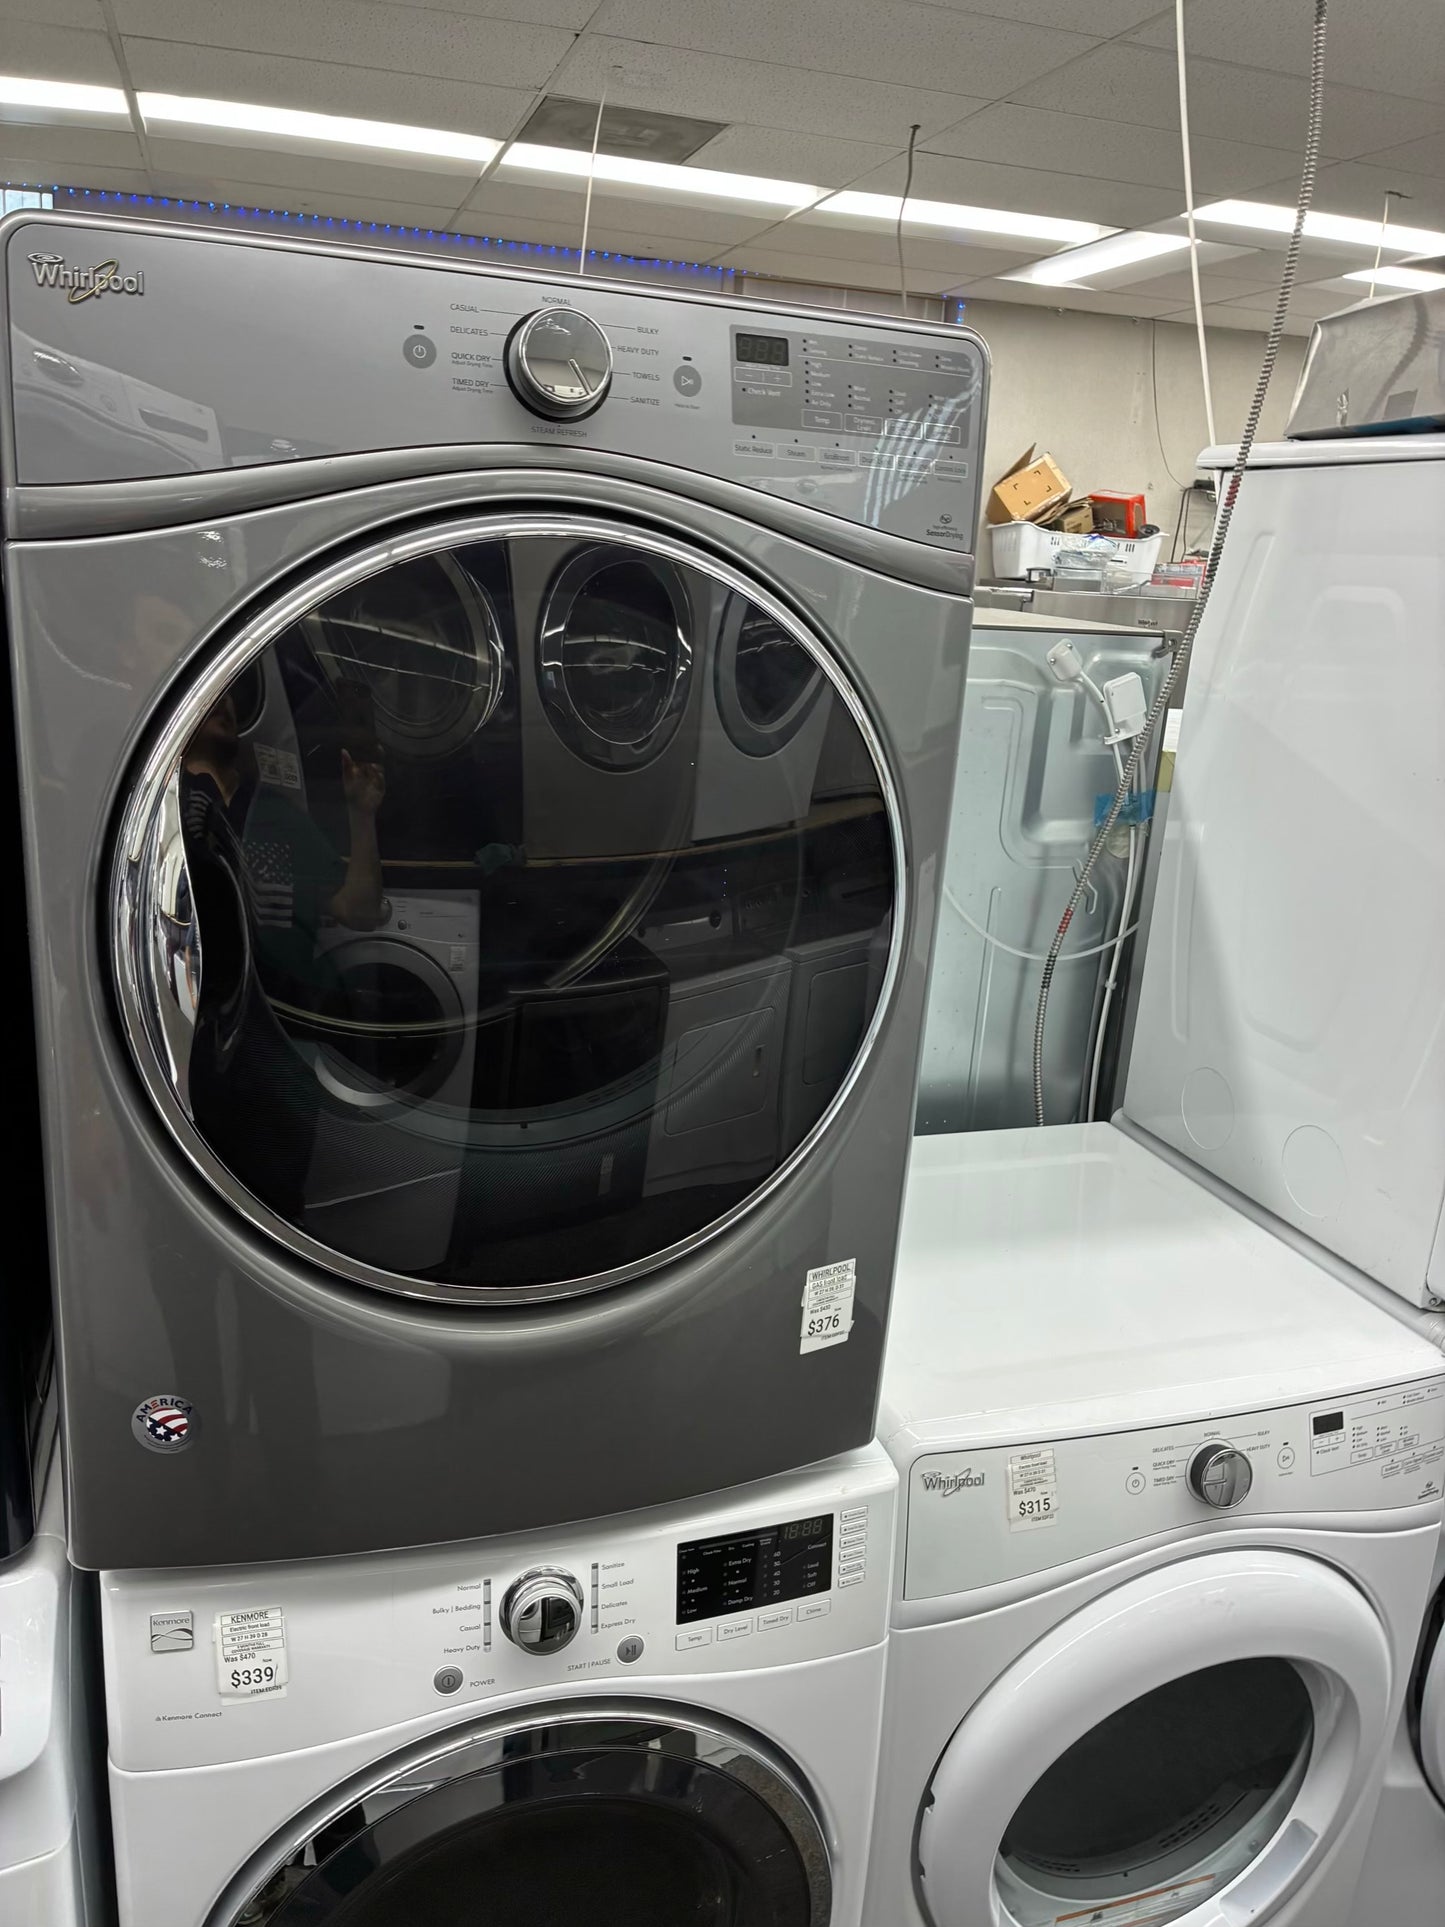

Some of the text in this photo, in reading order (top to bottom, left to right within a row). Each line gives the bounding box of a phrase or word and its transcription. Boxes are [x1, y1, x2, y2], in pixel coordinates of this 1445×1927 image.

[30, 259, 145, 301] Whirlpool
[542, 296, 571, 305] NORMAL
[450, 303, 479, 313] CASUAL
[450, 326, 489, 336] DELICATES
[637, 326, 659, 335] BULKY
[617, 345, 659, 356] HEAVY DUTY
[451, 352, 491, 362] QUICK DRY
[632, 372, 660, 381] TOWELS
[452, 378, 490, 388] TIMED DRY
[630, 397, 660, 406] SANITIZE
[531, 426, 587, 437] STEAM REFRESH
[812, 1263, 851, 1280] WHIRLPOOL
[808, 1313, 840, 1336] $376
[136, 1398, 192, 1423] AMERICA
[922, 1470, 985, 1497] Whirlpool
[1018, 1497, 1051, 1518] $315
[601, 1562, 625, 1571] Sanitize
[687, 1567, 700, 1575] High
[457, 1583, 481, 1592] Normal
[601, 1578, 635, 1590] Small Load
[432, 1604, 481, 1615] Bulky Bedding
[601, 1601, 628, 1610] Delicates
[806, 1607, 822, 1615] Chime
[153, 1616, 190, 1627] Kenmore
[230, 1610, 269, 1624] KENMORE
[763, 1615, 789, 1626] Timed Dry
[230, 1624, 247, 1632] Electric
[247, 1622, 259, 1630] front
[459, 1624, 481, 1632] Casual
[601, 1621, 623, 1629] Express
[723, 1625, 748, 1636] Dry Level
[239, 1652, 256, 1661] $470
[567, 1658, 611, 1671] START PAUSE
[231, 1666, 274, 1689] $339
[469, 1678, 496, 1687] POWER
[161, 1711, 223, 1722] Kenmore Connect
